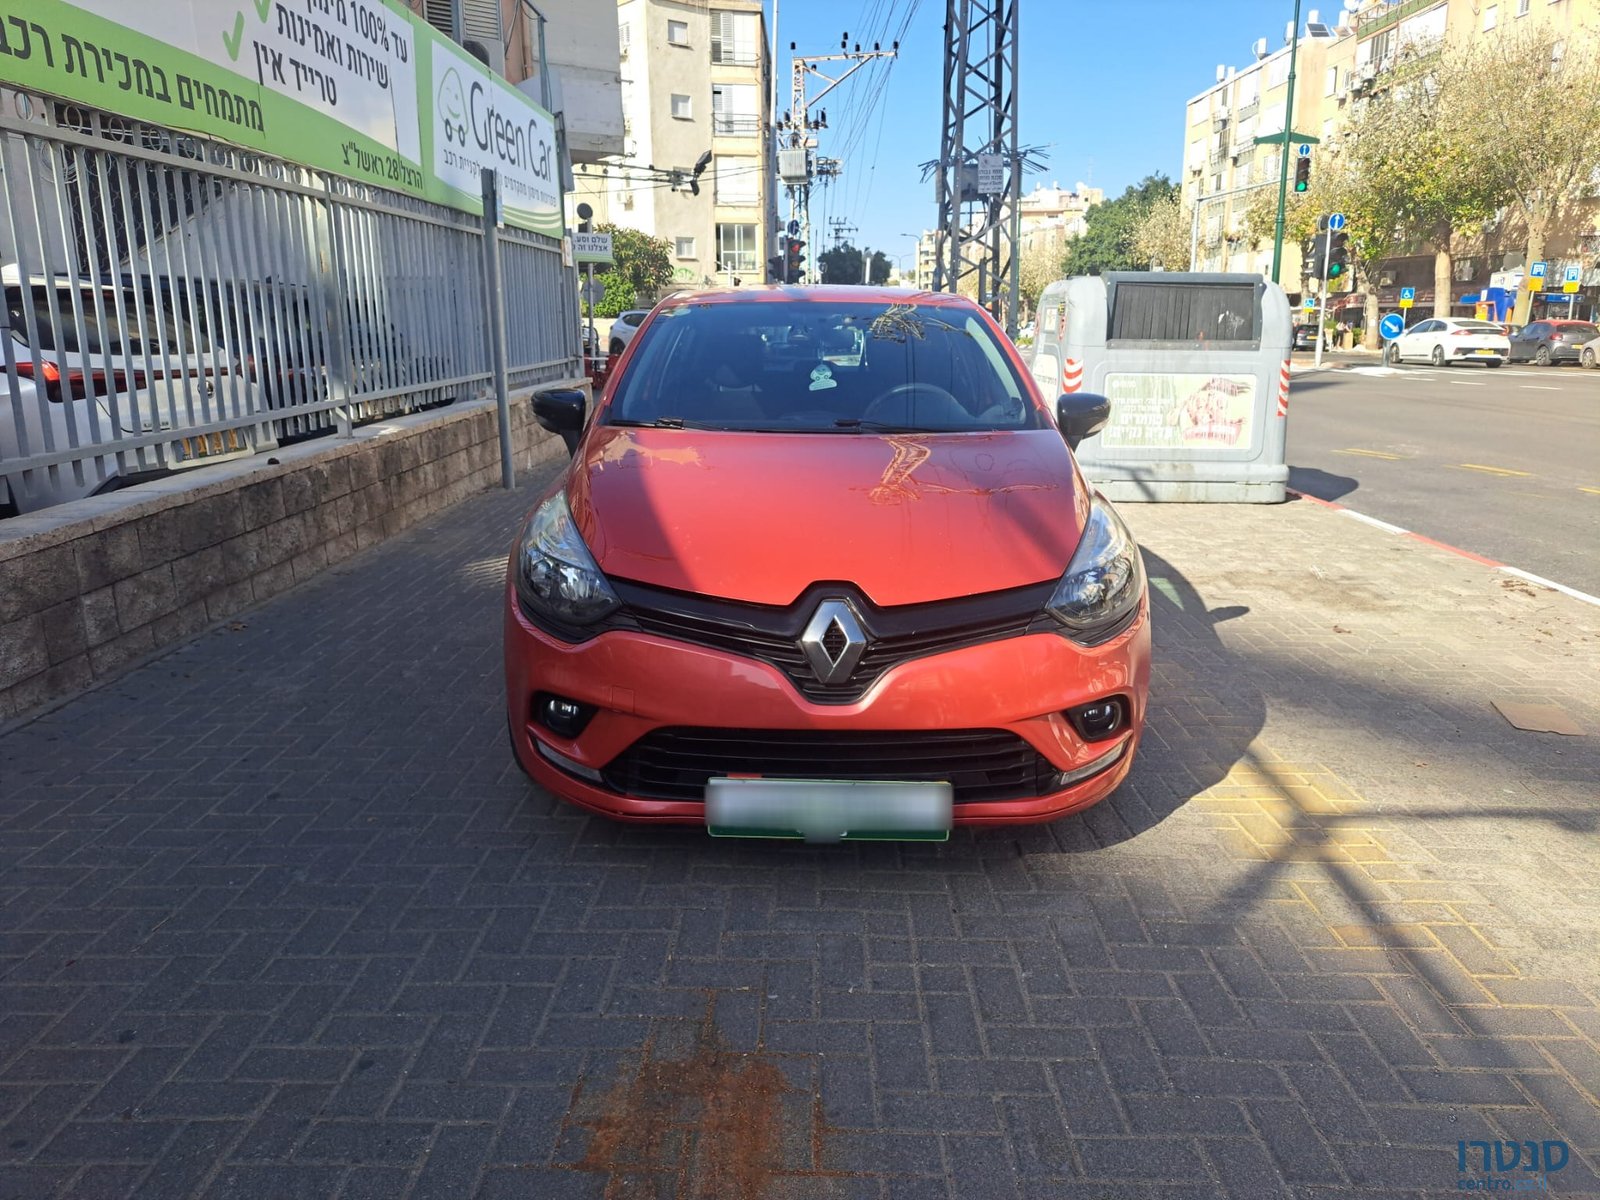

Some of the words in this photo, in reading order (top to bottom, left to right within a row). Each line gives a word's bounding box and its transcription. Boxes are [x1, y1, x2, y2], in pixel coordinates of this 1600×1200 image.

[276, 2, 344, 66] ואמינות
[351, 1, 389, 52] 100%
[391, 31, 408, 63] עד
[61, 33, 172, 103] במכירת
[253, 40, 287, 86] אין
[289, 58, 337, 106] טרייד
[346, 43, 389, 89] שירות
[176, 73, 265, 132] מתמחים
[470, 81, 527, 169] Green
[528, 119, 552, 183] Car
[386, 156, 399, 181] 28
[400, 160, 423, 190] הרצל
[443, 149, 458, 168] רכב
[588, 243, 608, 252] אצלנו
[591, 235, 608, 243] שלם
